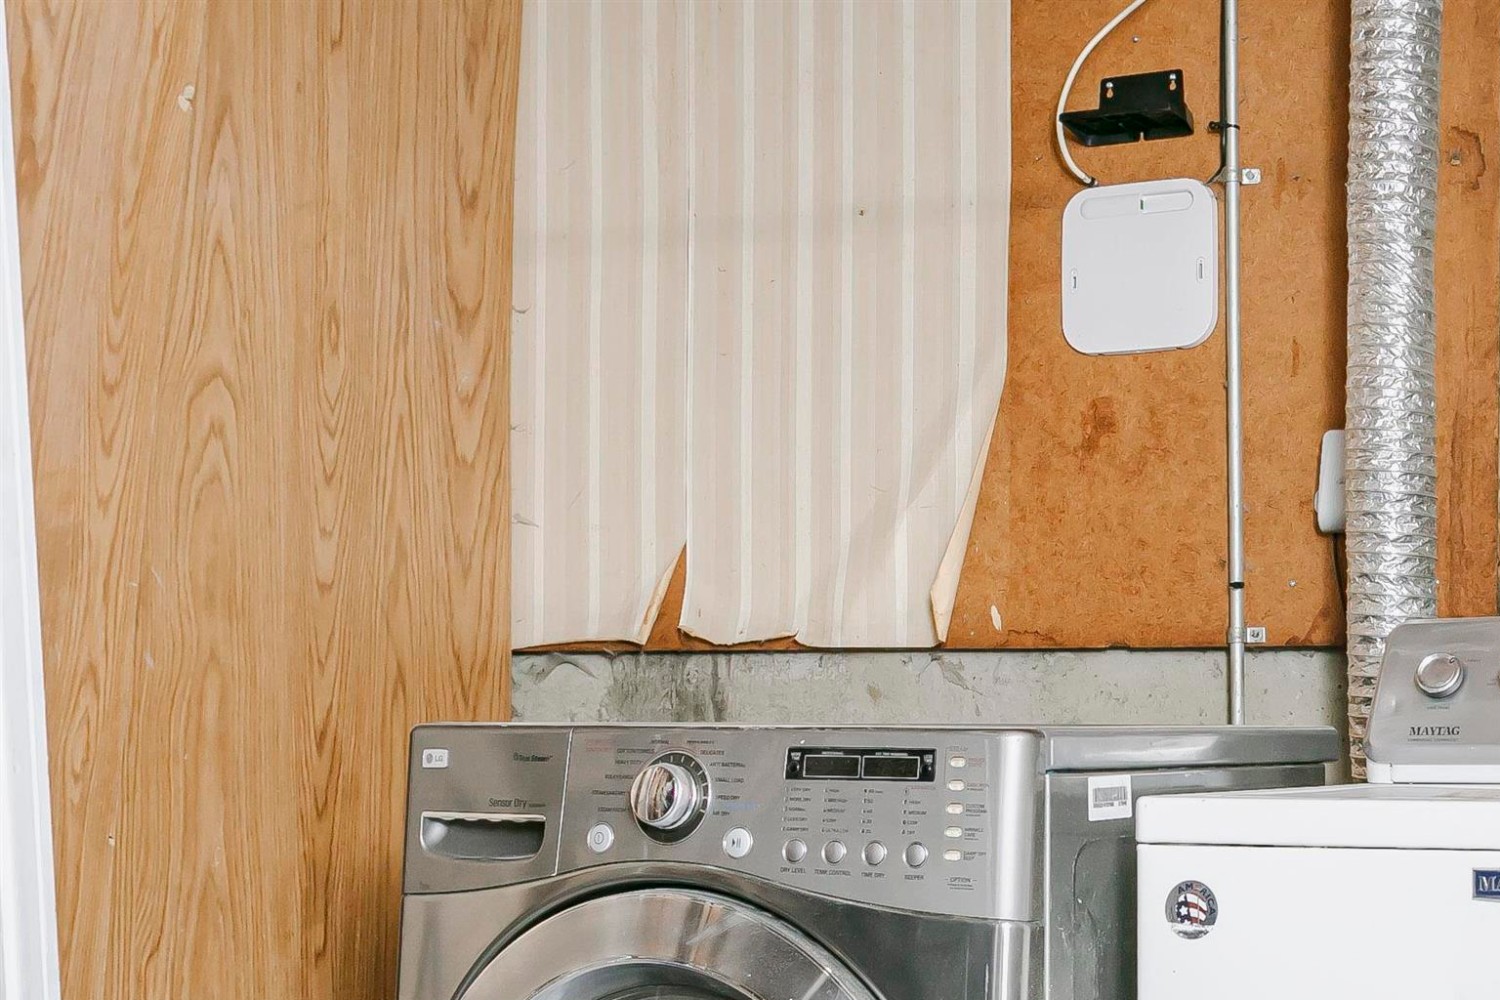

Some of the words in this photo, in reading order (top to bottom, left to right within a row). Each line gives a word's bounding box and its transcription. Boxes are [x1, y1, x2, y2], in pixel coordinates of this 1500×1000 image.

[1409, 726, 1461, 736] MAYTAG
[488, 797, 513, 808] Sensor
[513, 798, 528, 809] Dry
